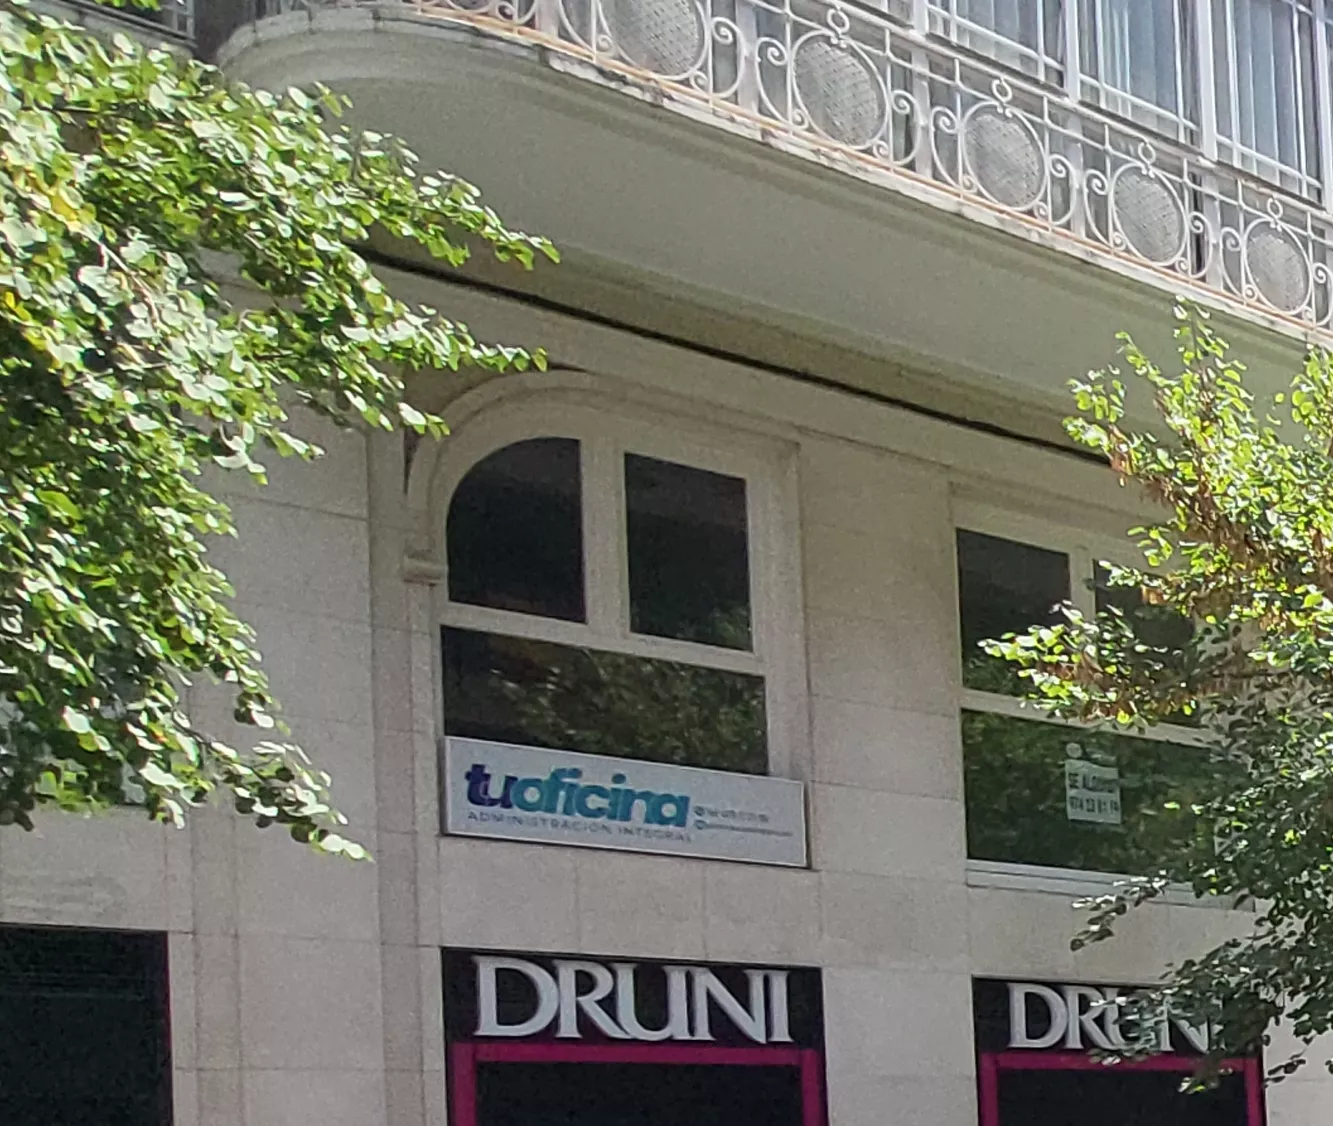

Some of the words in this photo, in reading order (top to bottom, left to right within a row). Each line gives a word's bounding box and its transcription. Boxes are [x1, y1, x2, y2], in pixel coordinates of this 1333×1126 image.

[465, 763, 691, 828] tuoficina
[472, 955, 794, 1044] DRUNI
[1008, 982, 1225, 1054] DRUN
